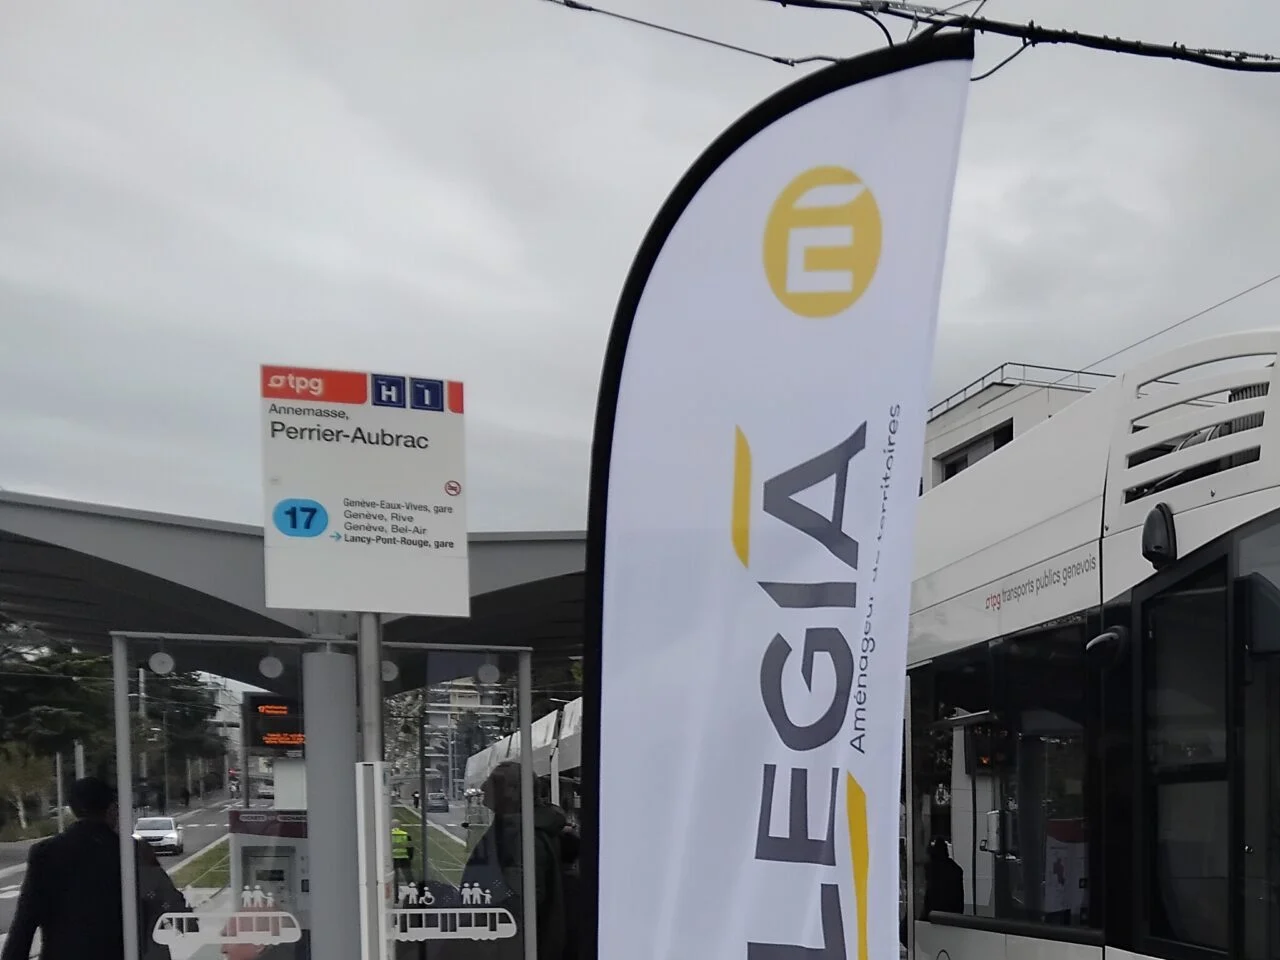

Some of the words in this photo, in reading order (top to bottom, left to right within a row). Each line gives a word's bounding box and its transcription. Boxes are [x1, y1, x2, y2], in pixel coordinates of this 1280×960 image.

[381, 385, 397, 402] H
[268, 403, 350, 420] Annemasse,
[270, 421, 429, 449] Perrier-Aubrac
[343, 497, 431, 513] Genève-Eaux-Vives,
[433, 504, 453, 514] gare
[284, 506, 318, 530] 17
[343, 509, 388, 522] Genève,
[391, 512, 414, 522] Rive
[344, 521, 388, 533] Genève,
[391, 524, 427, 535] Bel-Air
[344, 533, 431, 548] Lancy-Pont-Rouge,
[434, 540, 454, 549] gare
[1001, 578, 1035, 603] transports
[1035, 568, 1061, 596] publics
[1061, 553, 1097, 586] genevois
